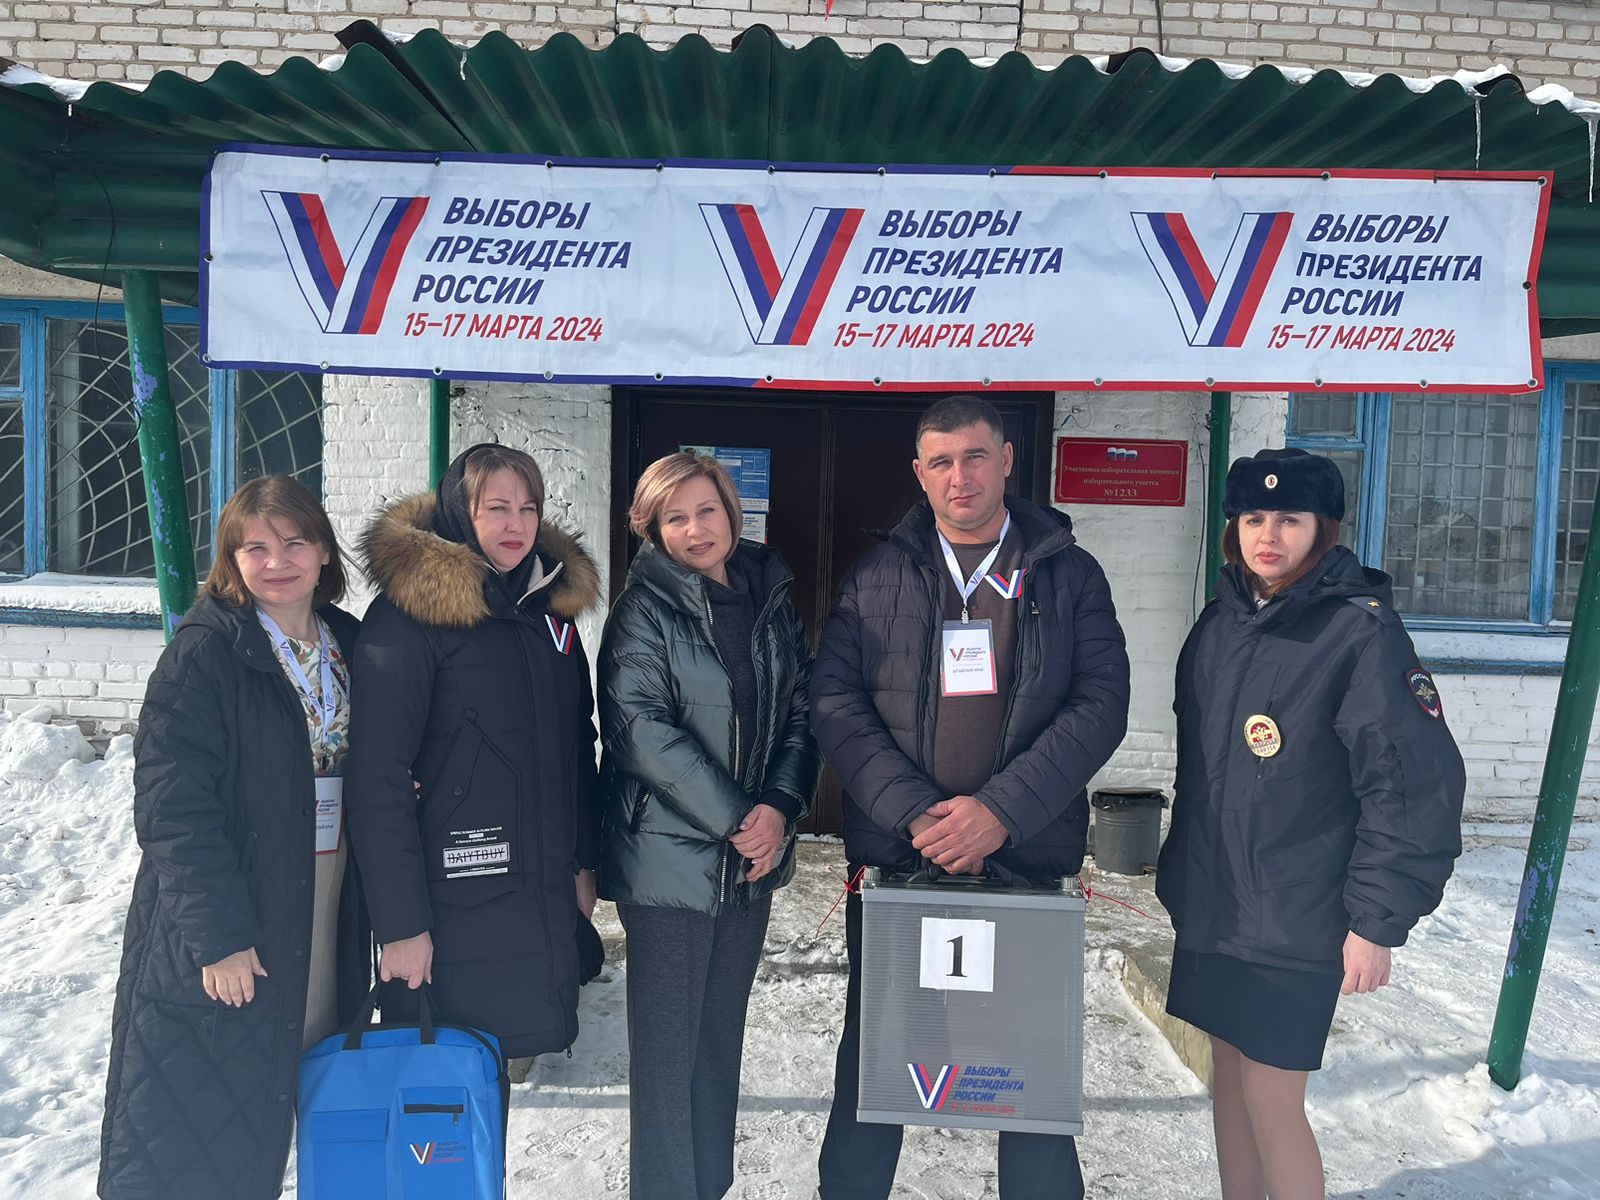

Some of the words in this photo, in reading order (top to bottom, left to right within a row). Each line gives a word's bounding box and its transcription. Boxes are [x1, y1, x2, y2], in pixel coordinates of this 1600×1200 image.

[442, 196, 592, 230] ВЫБОРЫ
[878, 209, 1023, 240] ВЫБОРЫ
[1305, 213, 1450, 244] ВЫБОРЫ
[424, 235, 632, 272] ПРЕЗИДЕНТА
[861, 247, 1064, 280] ПРЕЗИДЕНТА
[1295, 251, 1483, 285] ПРЕЗИДЕНТА
[412, 274, 545, 306] РОССИИ
[845, 285, 977, 315] РОССИИ
[1280, 286, 1405, 317] РОССИИ
[466, 313, 543, 339] МАРТА
[545, 316, 602, 342] 2024
[898, 323, 975, 349] МАРТА
[976, 322, 1035, 349] 2024
[1330, 325, 1404, 350] МАРТА
[1402, 327, 1456, 352] 2024
[945, 935, 968, 978] 1
[964, 1065, 1012, 1077] ВЫБОРЫ
